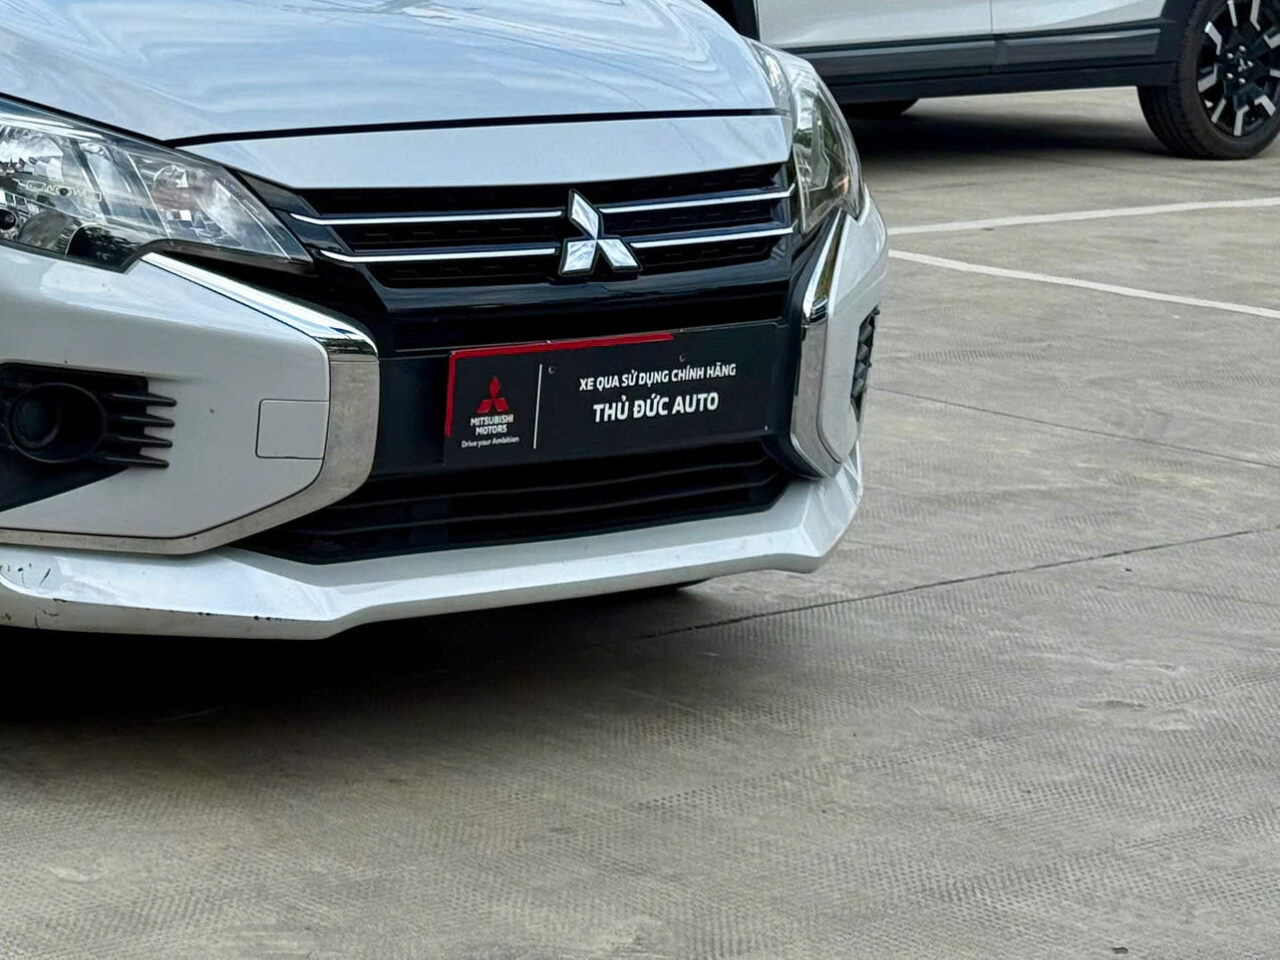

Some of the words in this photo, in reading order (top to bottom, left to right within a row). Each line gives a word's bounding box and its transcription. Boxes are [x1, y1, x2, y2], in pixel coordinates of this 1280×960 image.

[579, 377, 594, 391] XE
[596, 375, 620, 391] QUA
[622, 369, 638, 387] SỬ
[638, 370, 669, 387] DỤNG
[671, 365, 705, 382] CHÍNH
[706, 362, 736, 378] HÃNG
[593, 395, 629, 423] THỦ
[633, 393, 669, 418] ĐỨC
[672, 392, 719, 415] AUTO
[470, 414, 514, 427] MITSUBISHI
[475, 424, 508, 436] MOTORS
